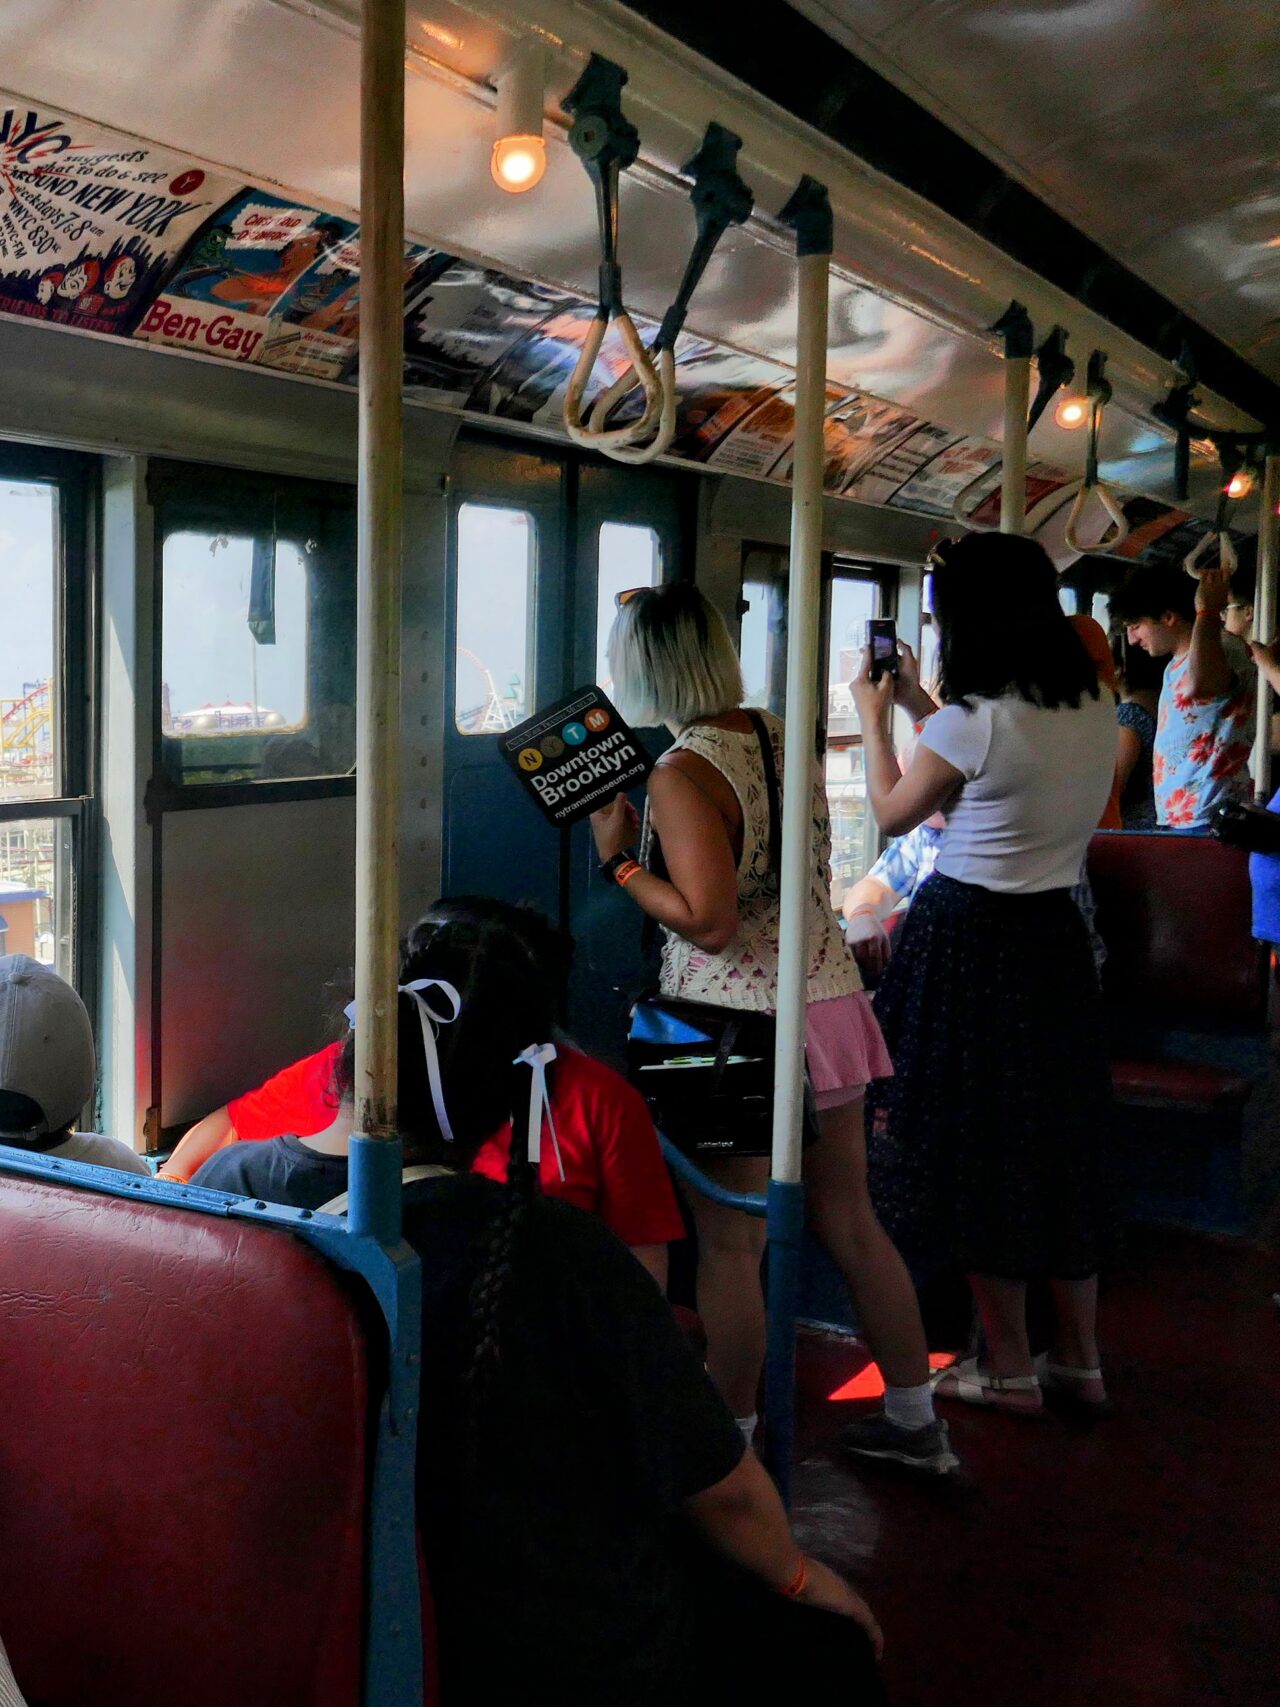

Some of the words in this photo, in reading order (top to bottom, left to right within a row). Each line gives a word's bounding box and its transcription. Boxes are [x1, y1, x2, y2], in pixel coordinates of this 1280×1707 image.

[63, 149, 150, 165] suggests
[76, 165, 93, 176] to
[95, 165, 117, 179] do
[131, 171, 168, 184] see
[8, 198, 37, 231] WNYC
[28, 225, 55, 255] 830
[14, 185, 65, 225] weekdays
[69, 182, 134, 215] NEW
[140, 300, 263, 361] Ben-Gay
[523, 752, 538, 767] N
[567, 727, 581, 741] T
[588, 712, 605, 728] M
[530, 731, 626, 792] Downtown
[540, 744, 637, 807] Brooklyn
[554, 762, 646, 819] nytransitmuseum.org
